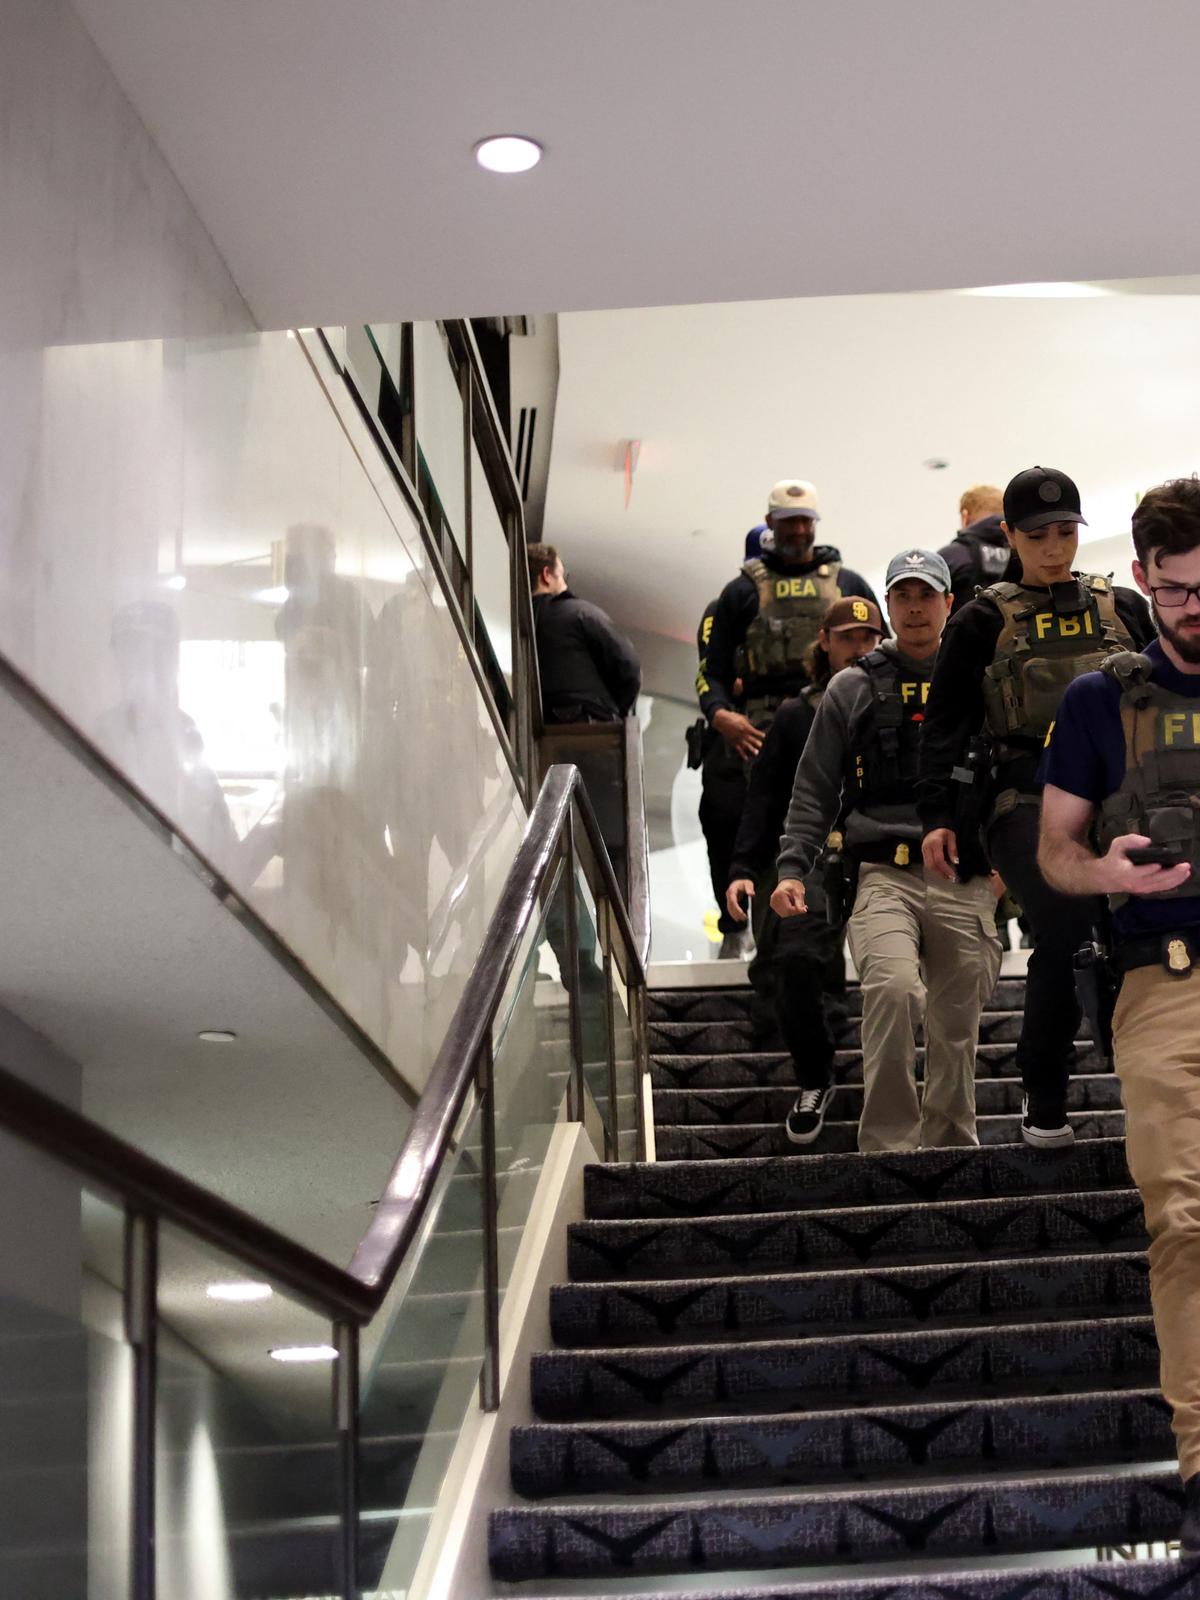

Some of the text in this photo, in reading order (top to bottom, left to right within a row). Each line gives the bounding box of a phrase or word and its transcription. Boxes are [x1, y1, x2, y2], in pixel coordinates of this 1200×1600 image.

[775, 578, 817, 600] DEA
[1035, 609, 1094, 639] FBI
[856, 755, 864, 789] FBI
